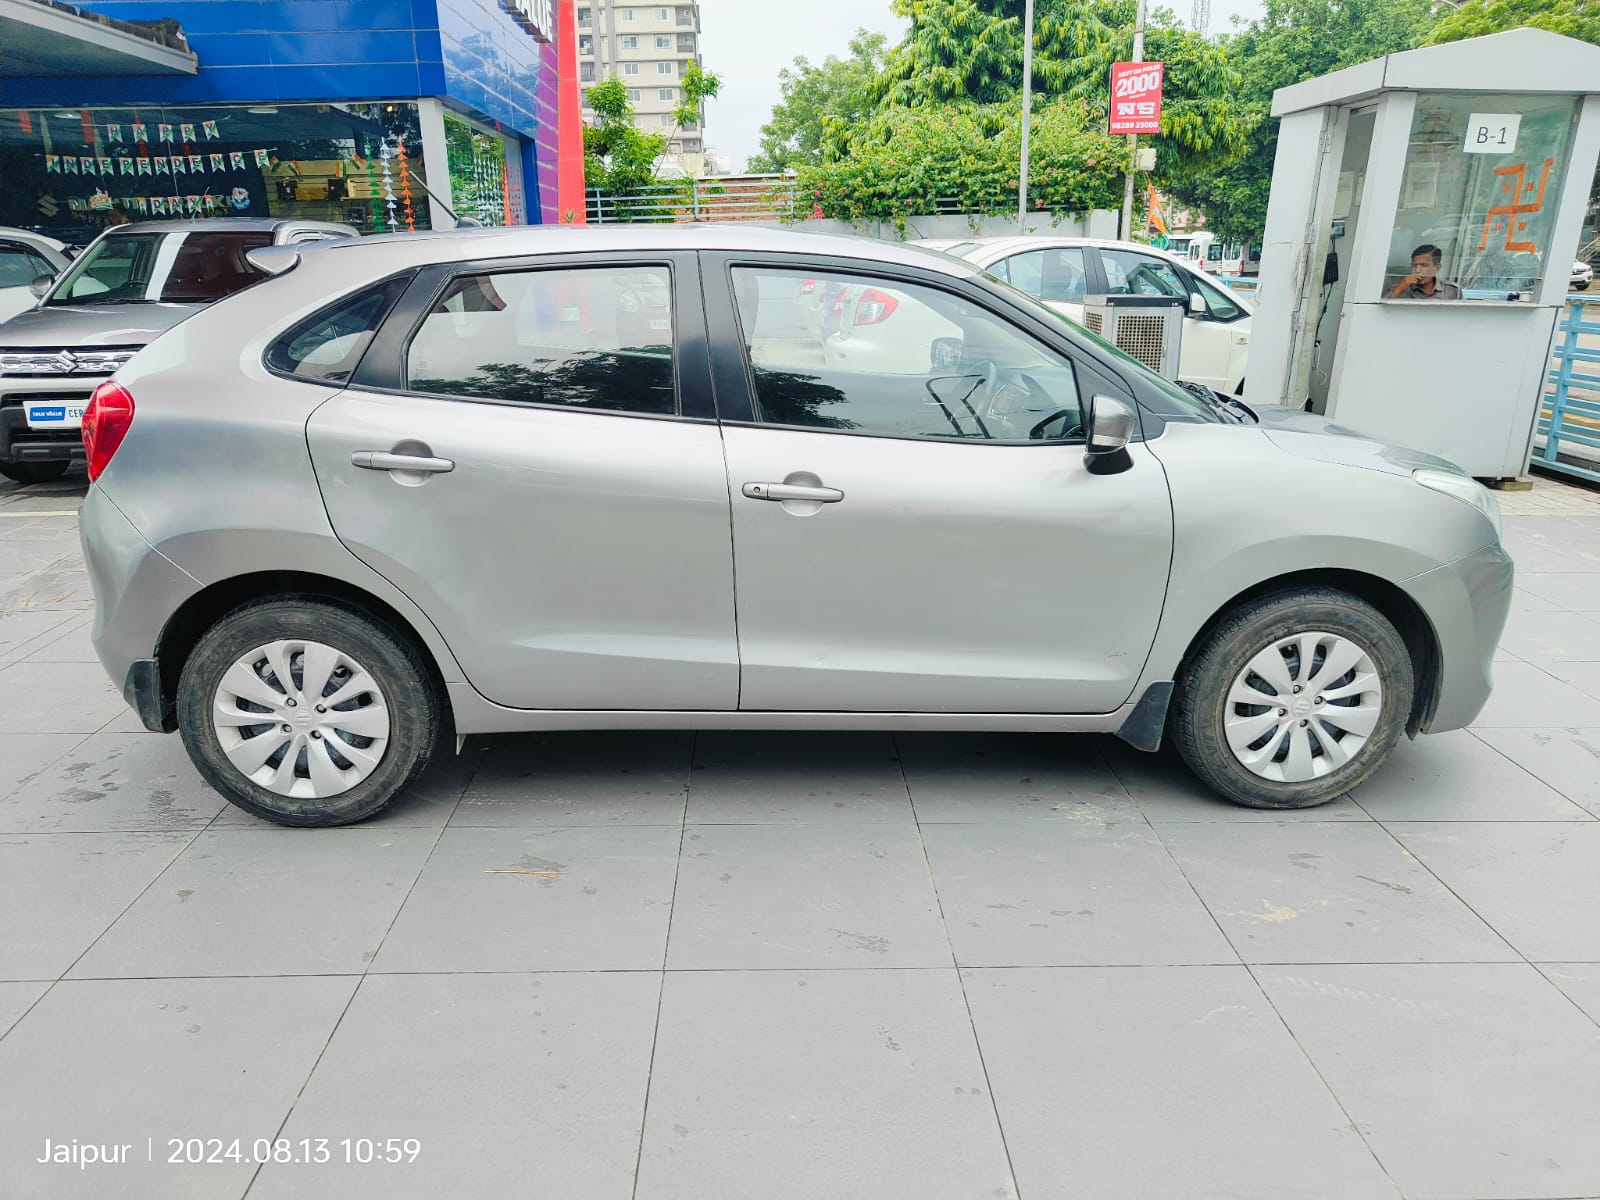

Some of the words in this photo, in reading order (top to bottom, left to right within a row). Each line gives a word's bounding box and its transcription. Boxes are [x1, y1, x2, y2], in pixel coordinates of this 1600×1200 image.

[110, 121, 216, 138] HAPPY
[1477, 126, 1506, 144] B-1
[48, 150, 266, 171] INDEPENDENCE
[152, 198, 199, 210] DAY
